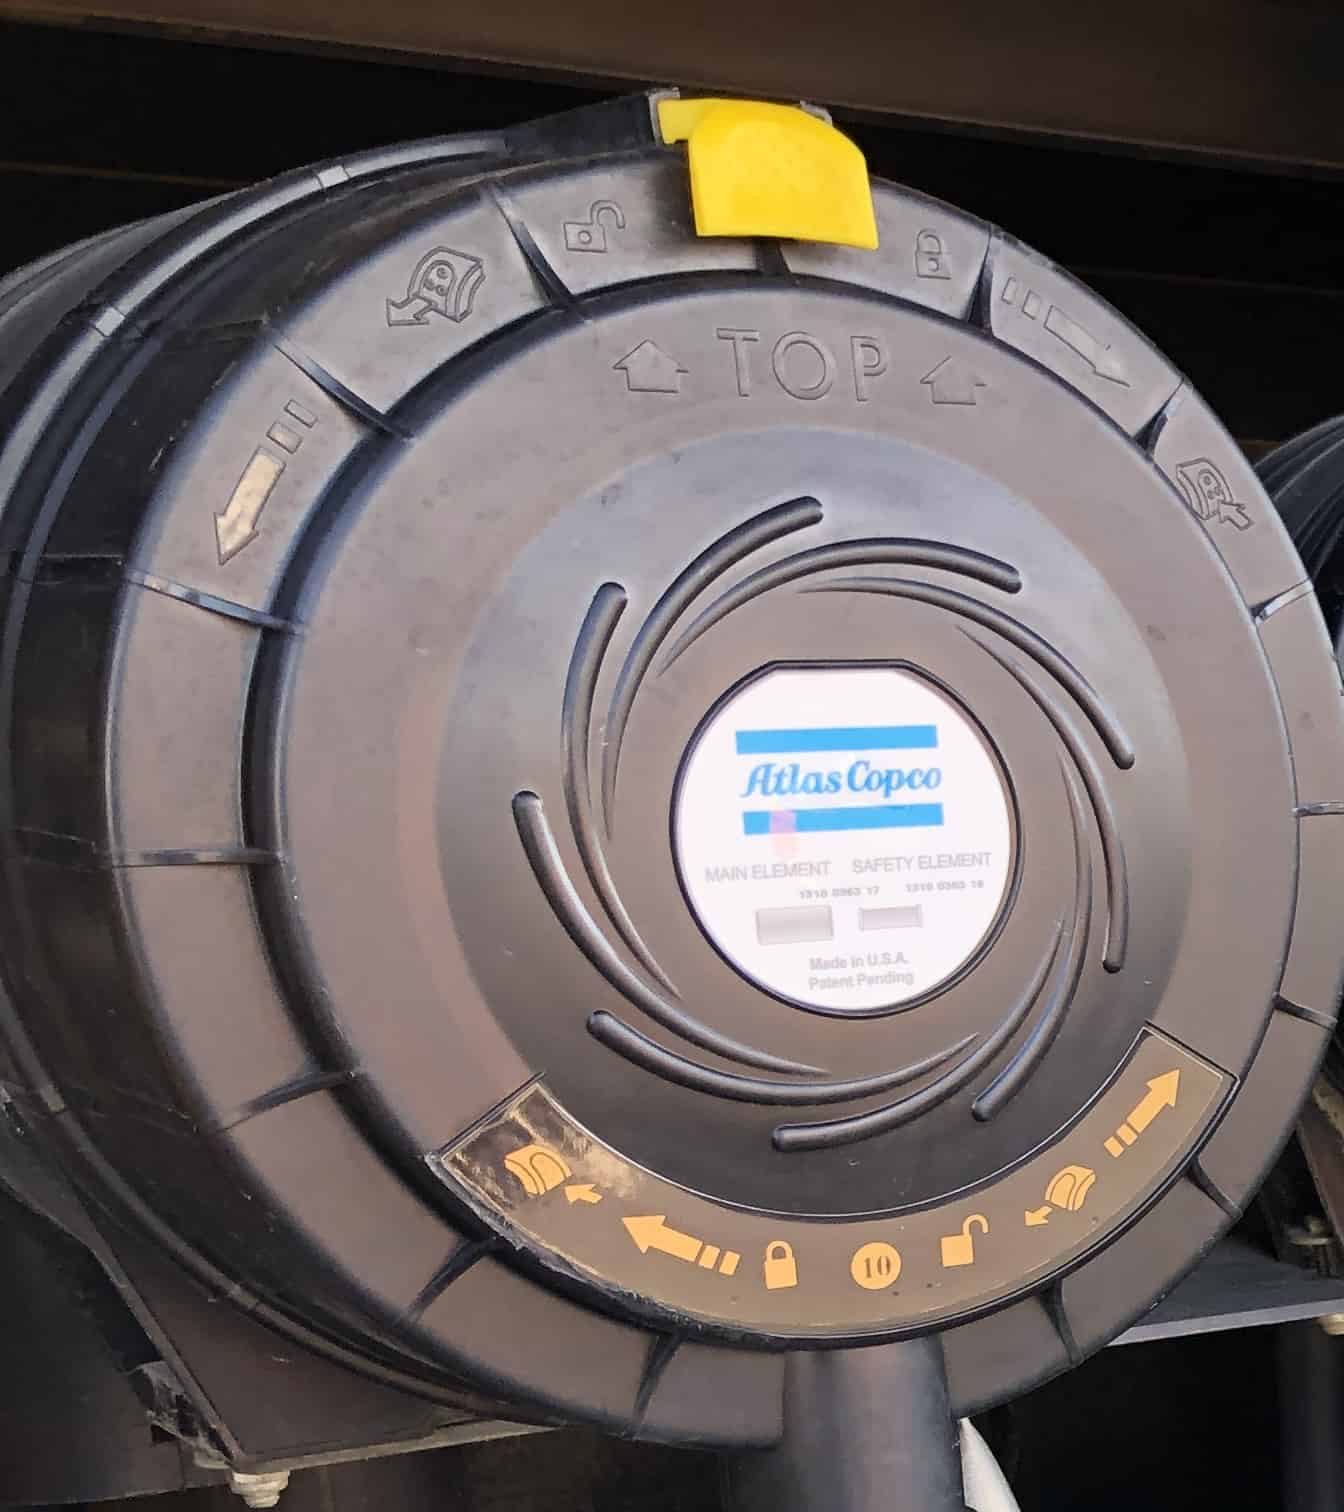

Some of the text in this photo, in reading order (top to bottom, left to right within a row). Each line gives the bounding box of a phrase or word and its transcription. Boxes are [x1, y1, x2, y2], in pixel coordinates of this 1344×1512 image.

[715, 327, 889, 402] TOP
[740, 759, 943, 798] Atlas Copco
[704, 860, 832, 882] MAIN ELEMENT
[852, 852, 993, 875] SAFETY ELEMENT
[809, 955, 848, 971] Made
[851, 955, 864, 969] in
[809, 971, 915, 991] Patent Pending
